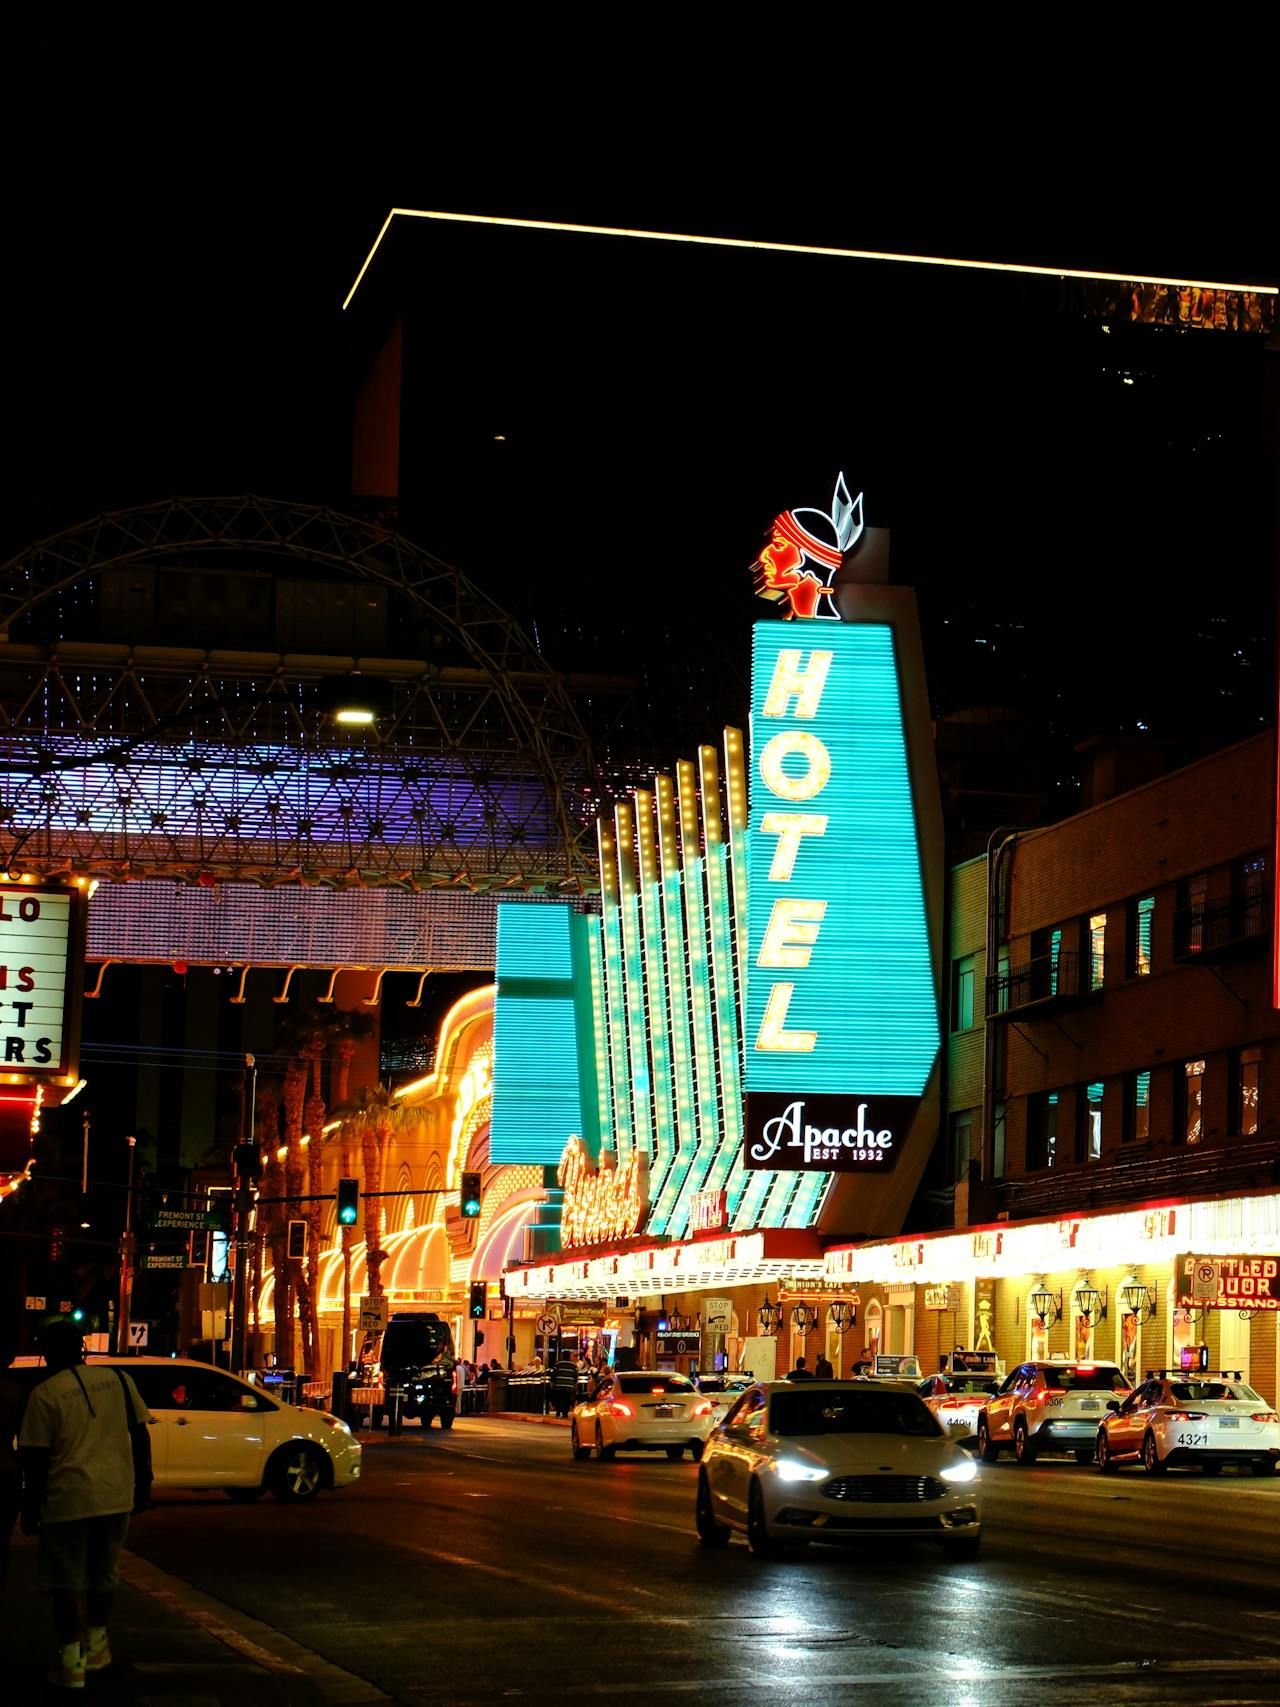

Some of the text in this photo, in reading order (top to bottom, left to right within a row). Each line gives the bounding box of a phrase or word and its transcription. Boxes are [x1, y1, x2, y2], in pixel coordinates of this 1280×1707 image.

[754, 649, 834, 1054] HOTEL
[750, 1101, 893, 1163] Apache
[852, 1149, 884, 1161] 1932
[158, 1211, 205, 1221] FREMONT ST
[157, 1220, 205, 1230] EXPERIENCE
[1183, 1258, 1278, 1278] BTTLED
[709, 1302, 729, 1310] STOP
[714, 1323, 729, 1331] RED
[1177, 1433, 1208, 1446] 4321
